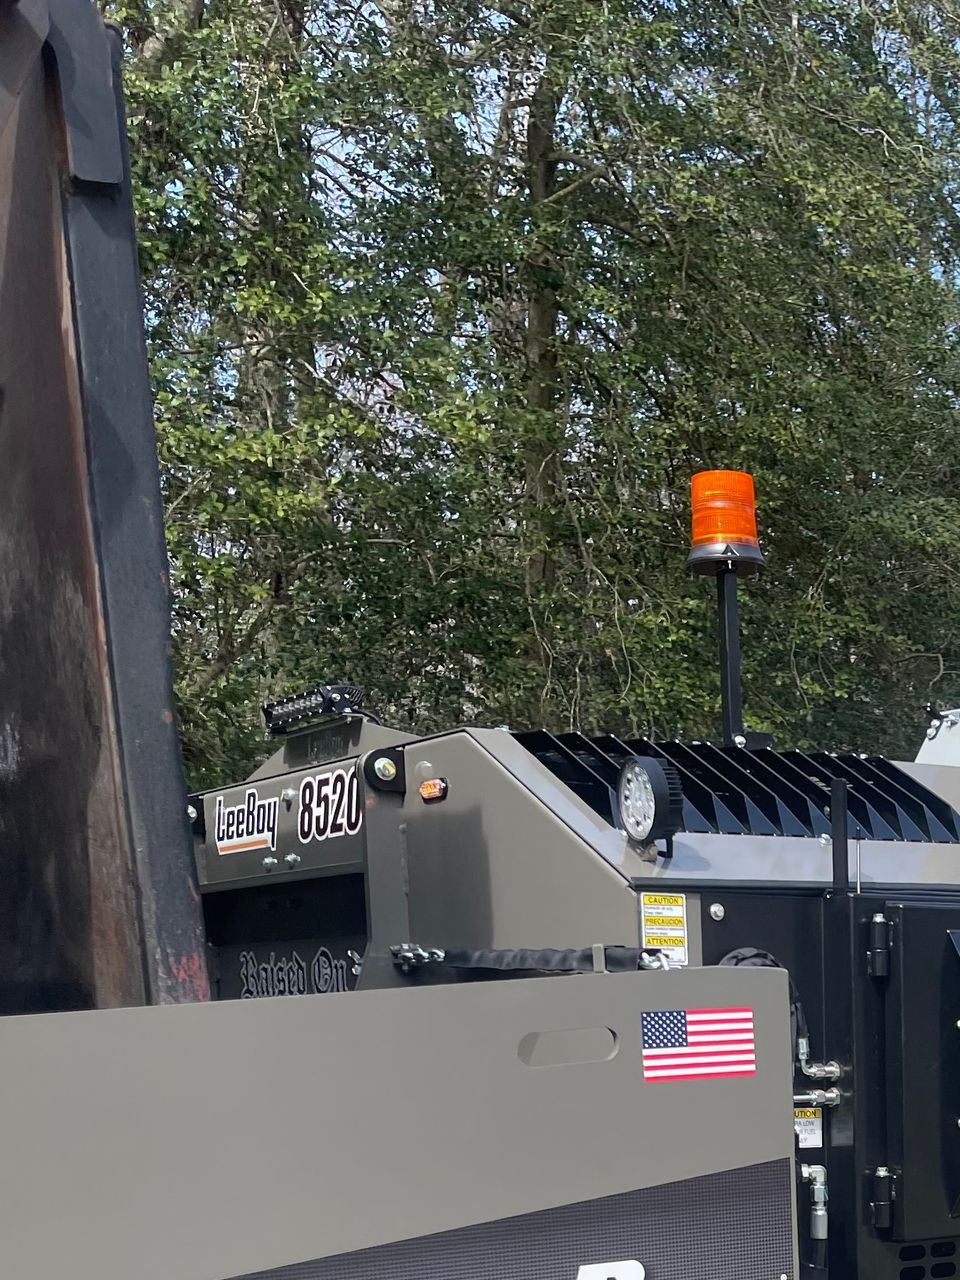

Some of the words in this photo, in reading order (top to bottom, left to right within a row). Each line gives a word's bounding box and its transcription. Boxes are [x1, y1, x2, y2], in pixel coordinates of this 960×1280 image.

[216, 790, 279, 850] LeeBoy
[299, 769, 362, 843] 8520
[647, 896, 679, 905] CAUTION
[646, 937, 684, 946] ATTENTION
[240, 951, 307, 998] Raised
[311, 947, 348, 994] On
[794, 1110, 817, 1118] UTION
